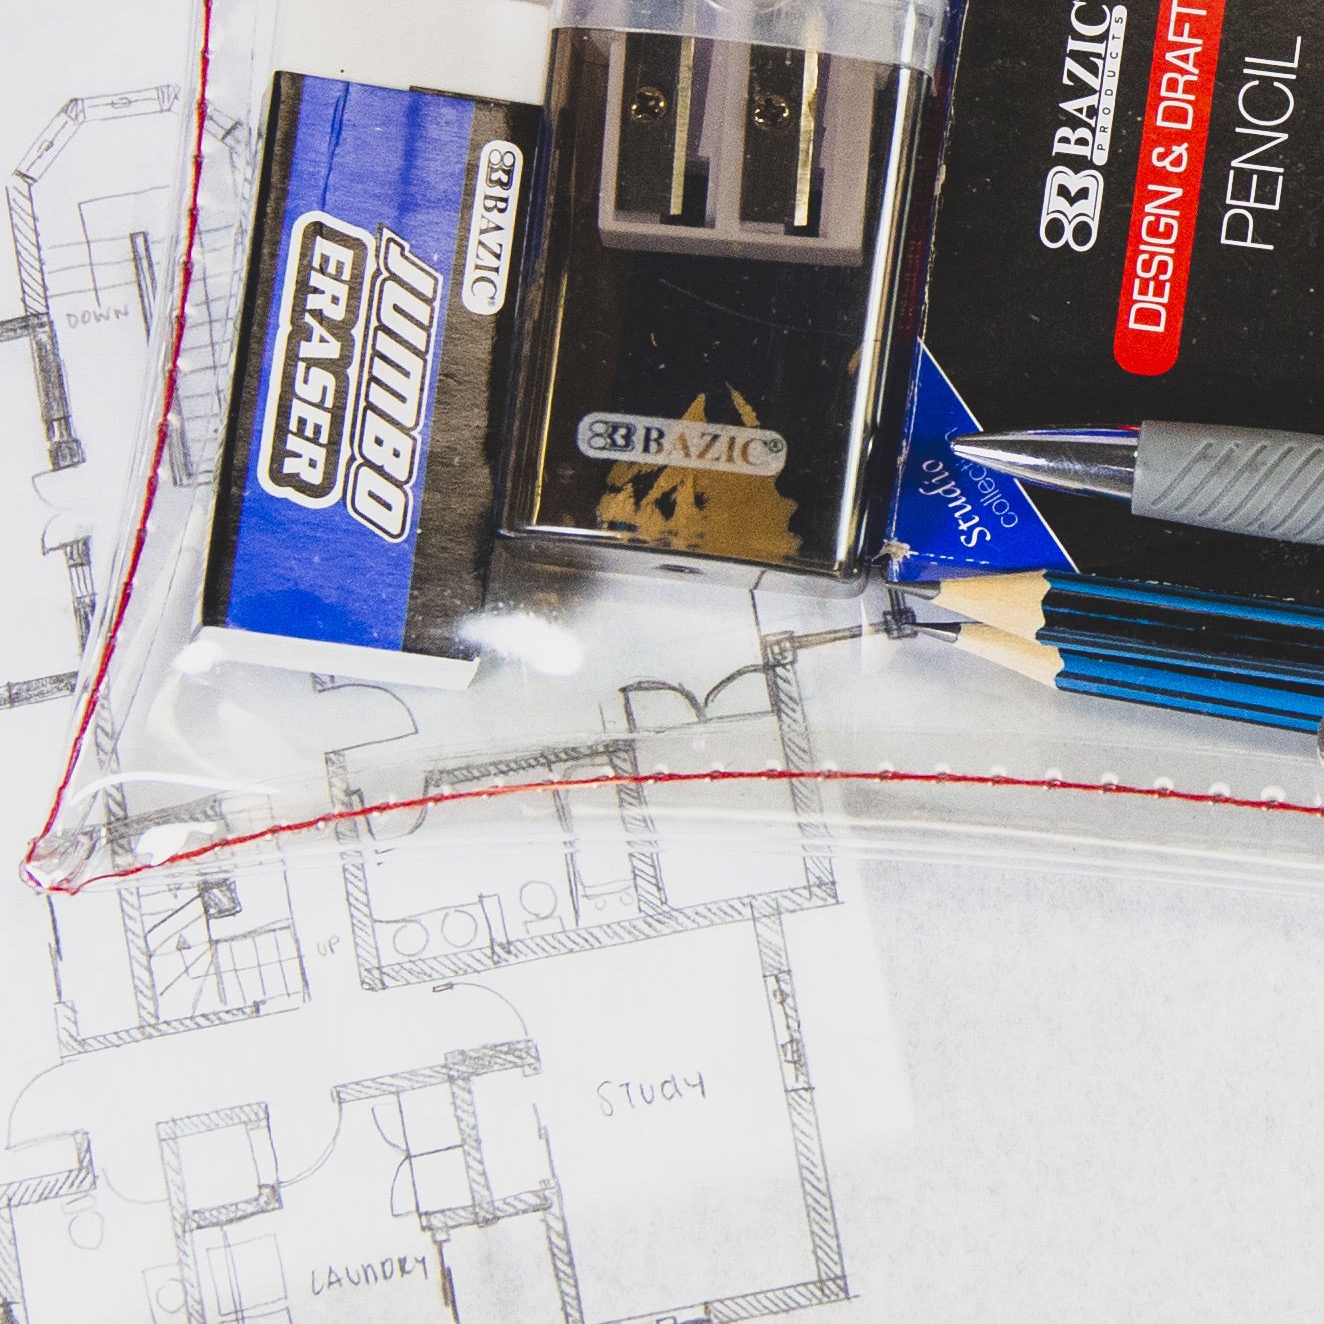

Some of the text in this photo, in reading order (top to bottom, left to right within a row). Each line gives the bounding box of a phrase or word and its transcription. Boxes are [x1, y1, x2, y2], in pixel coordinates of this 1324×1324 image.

[1052, 1, 1111, 161] BAZIC
[1096, 16, 1124, 151] PRODUCTS
[1220, 35, 1302, 250] PENCIL
[1151, 141, 1189, 173] &
[470, 195, 511, 313] BAZIC
[1128, 184, 1185, 334] DESIGN
[282, 233, 354, 491] ERASER
[350, 227, 443, 542] JUMBO
[641, 425, 764, 466] BAZIC
[918, 459, 992, 548] Studio
[316, 935, 341, 958] UP
